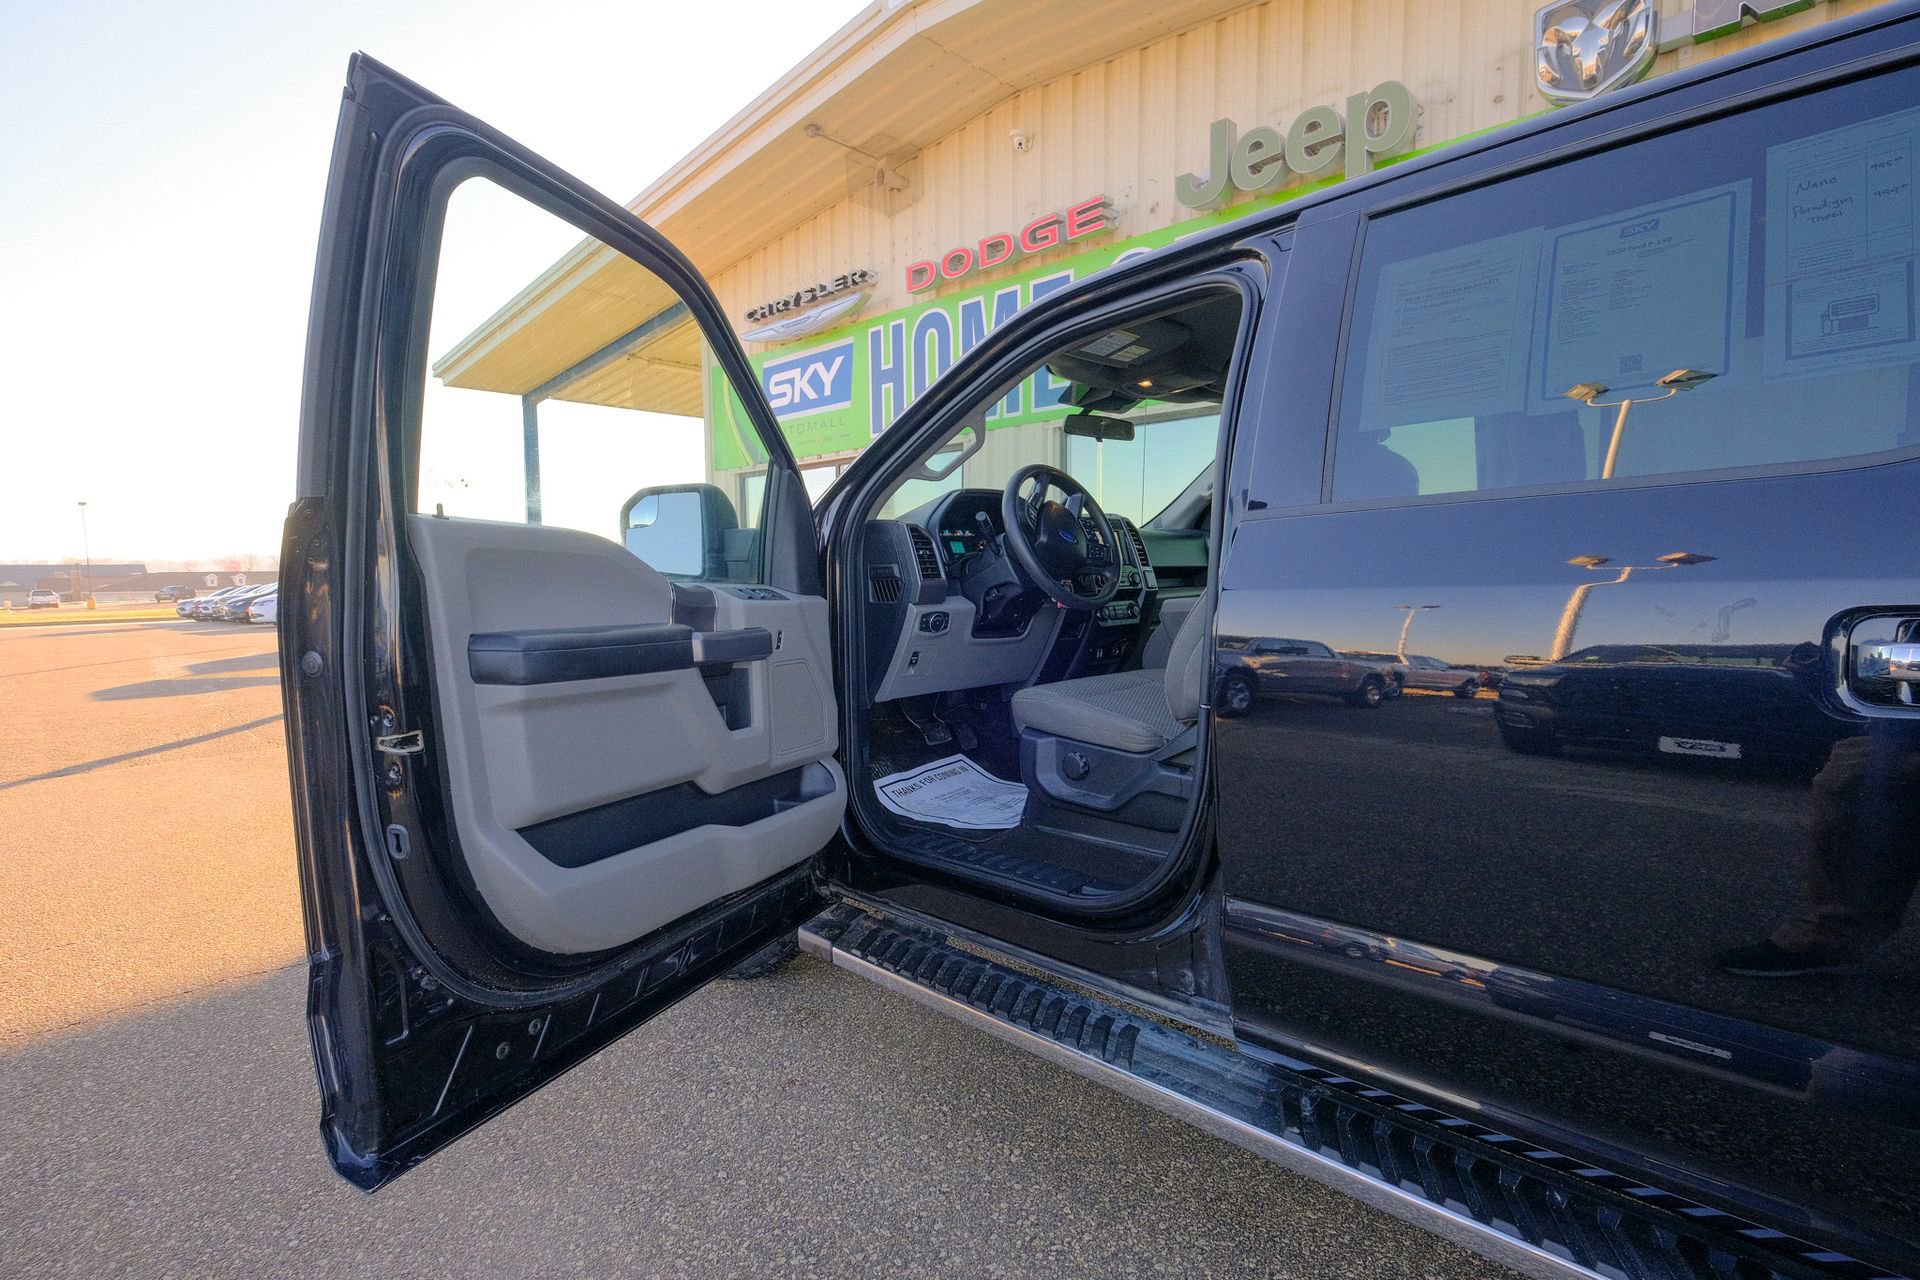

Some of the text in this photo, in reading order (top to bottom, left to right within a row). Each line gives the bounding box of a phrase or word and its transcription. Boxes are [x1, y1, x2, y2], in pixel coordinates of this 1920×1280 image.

[1176, 80, 1416, 209] Jeep
[905, 195, 1108, 294] DODGE
[744, 269, 872, 323] CHRYSLER
[769, 355, 845, 409] SKY
[784, 414, 847, 437] TOMALL
[892, 782, 923, 799] THANKS
[920, 774, 936, 788] FOR
[936, 768, 963, 783] COMING
[961, 765, 970, 774] IN
